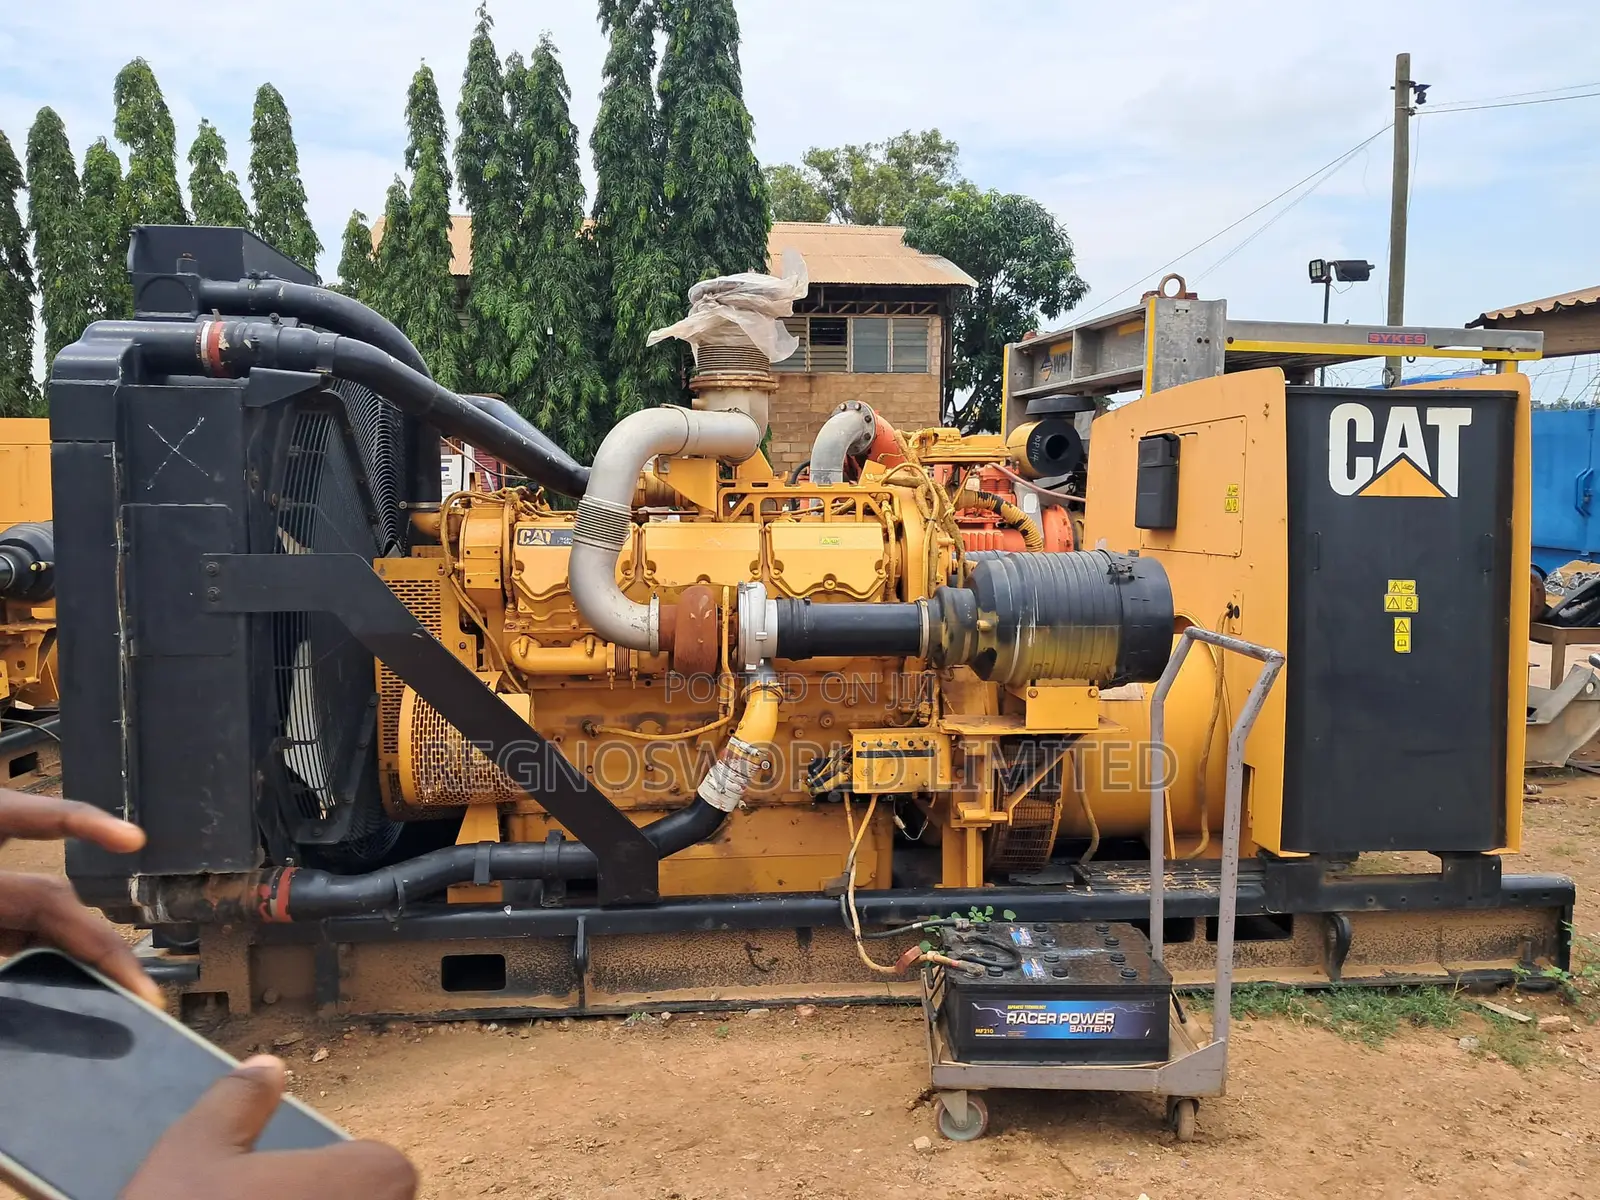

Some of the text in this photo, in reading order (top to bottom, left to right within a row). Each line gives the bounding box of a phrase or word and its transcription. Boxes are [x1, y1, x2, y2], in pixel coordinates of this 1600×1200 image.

[1369, 333, 1425, 344] SYKES
[1328, 402, 1473, 498] CAT
[518, 529, 553, 545] CAT
[1006, 1012, 1115, 1025] RACER POWER
[1069, 1024, 1114, 1034] BATTERY
